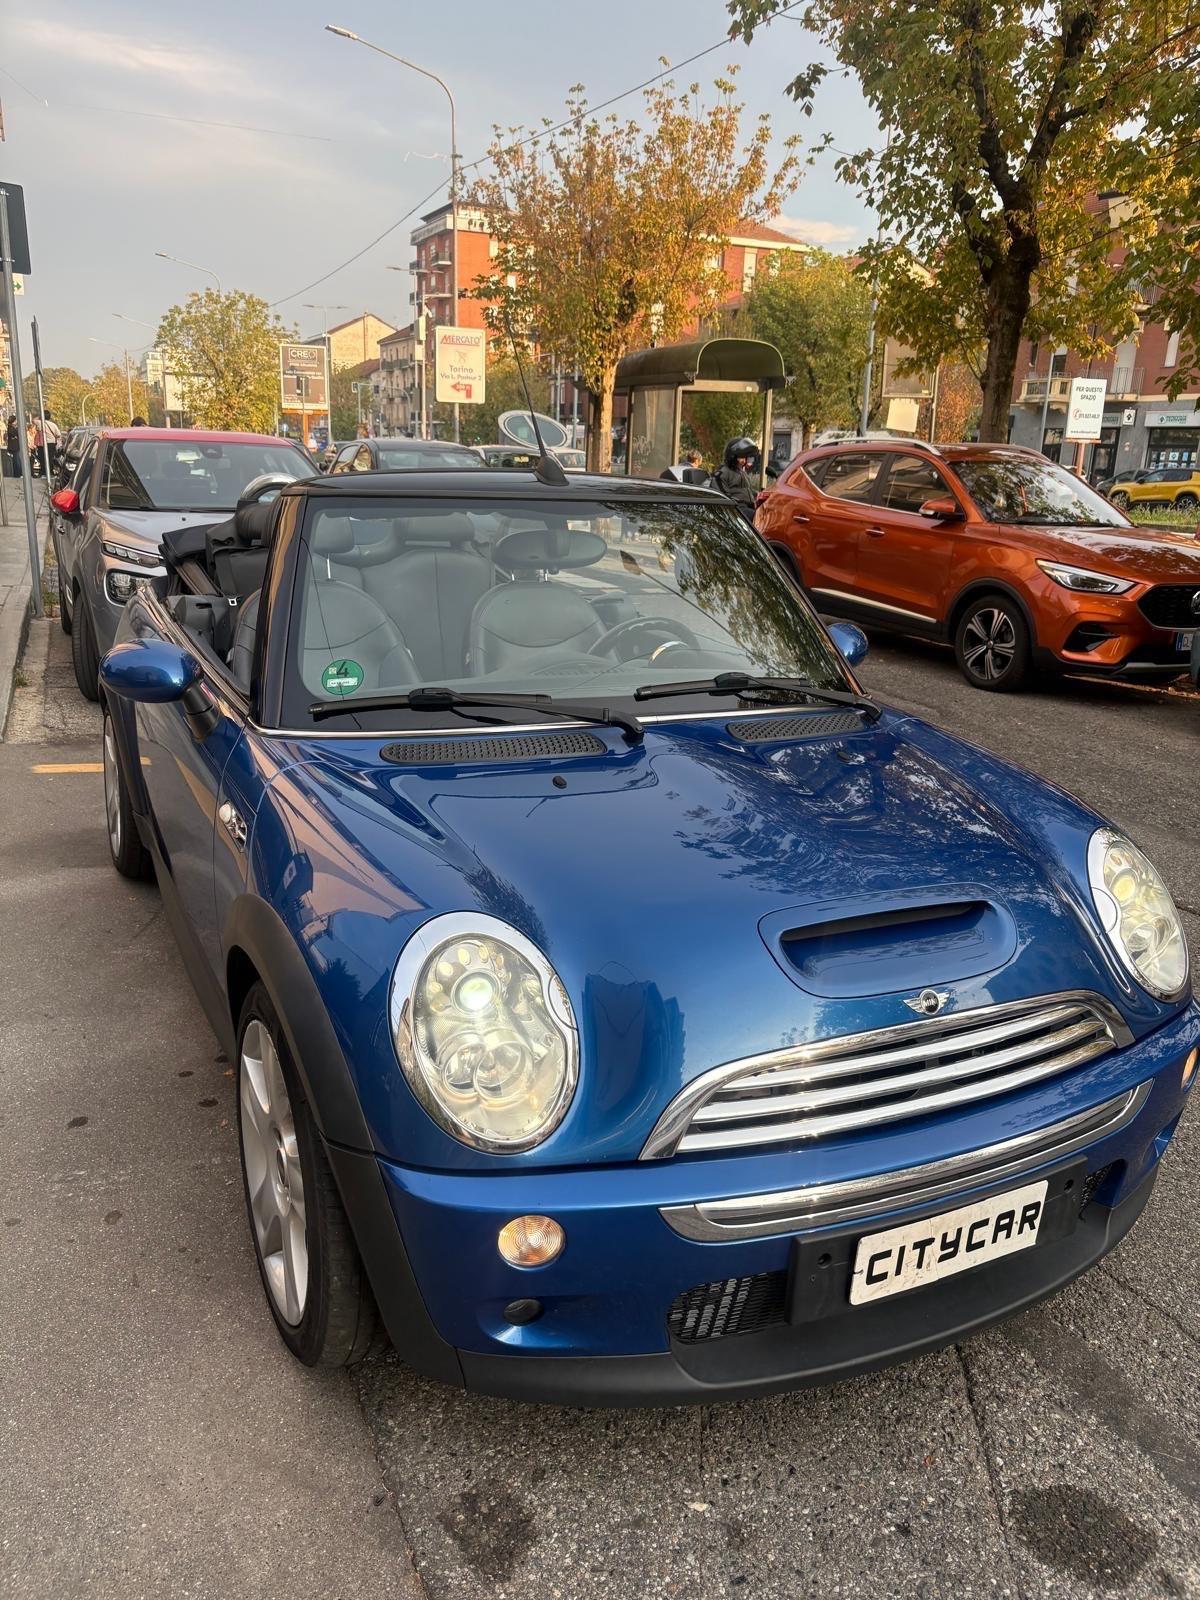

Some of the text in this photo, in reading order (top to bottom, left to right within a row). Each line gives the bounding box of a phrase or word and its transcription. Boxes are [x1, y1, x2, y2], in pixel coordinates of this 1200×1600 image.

[440, 335, 480, 345] MERCATO
[290, 350, 316, 359] CREO
[449, 365, 473, 373] Torino
[336, 661, 349, 678] 4
[865, 1200, 1042, 1286] CITYCAR
